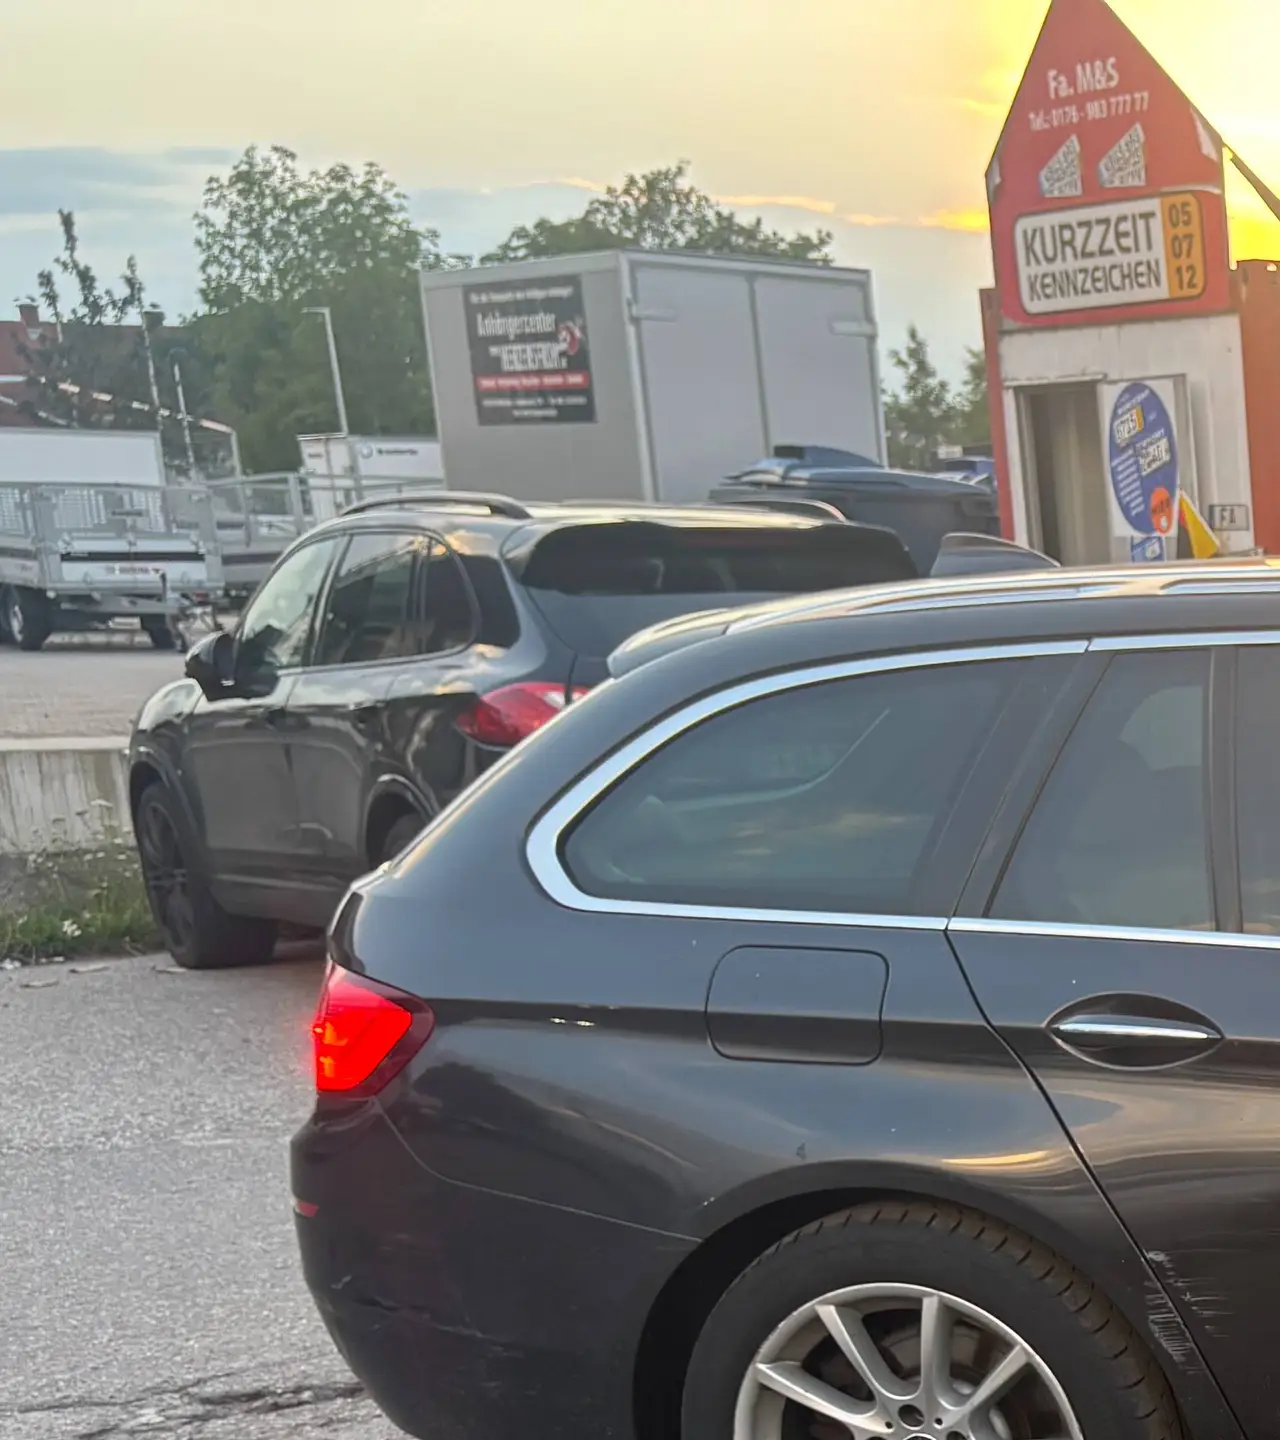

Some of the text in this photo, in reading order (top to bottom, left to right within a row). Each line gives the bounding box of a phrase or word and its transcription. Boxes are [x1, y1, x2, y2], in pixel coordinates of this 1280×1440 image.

[1047, 56, 1119, 99] Fa. M&S
[1110, 94, 1131, 116] 777
[1133, 91, 1149, 112] 77
[1168, 202, 1192, 229] 05
[1022, 211, 1156, 268] KURZZEIT
[1172, 233, 1194, 259] 07
[1027, 258, 1162, 302] KENNZEICHEN
[1175, 265, 1198, 290] 12
